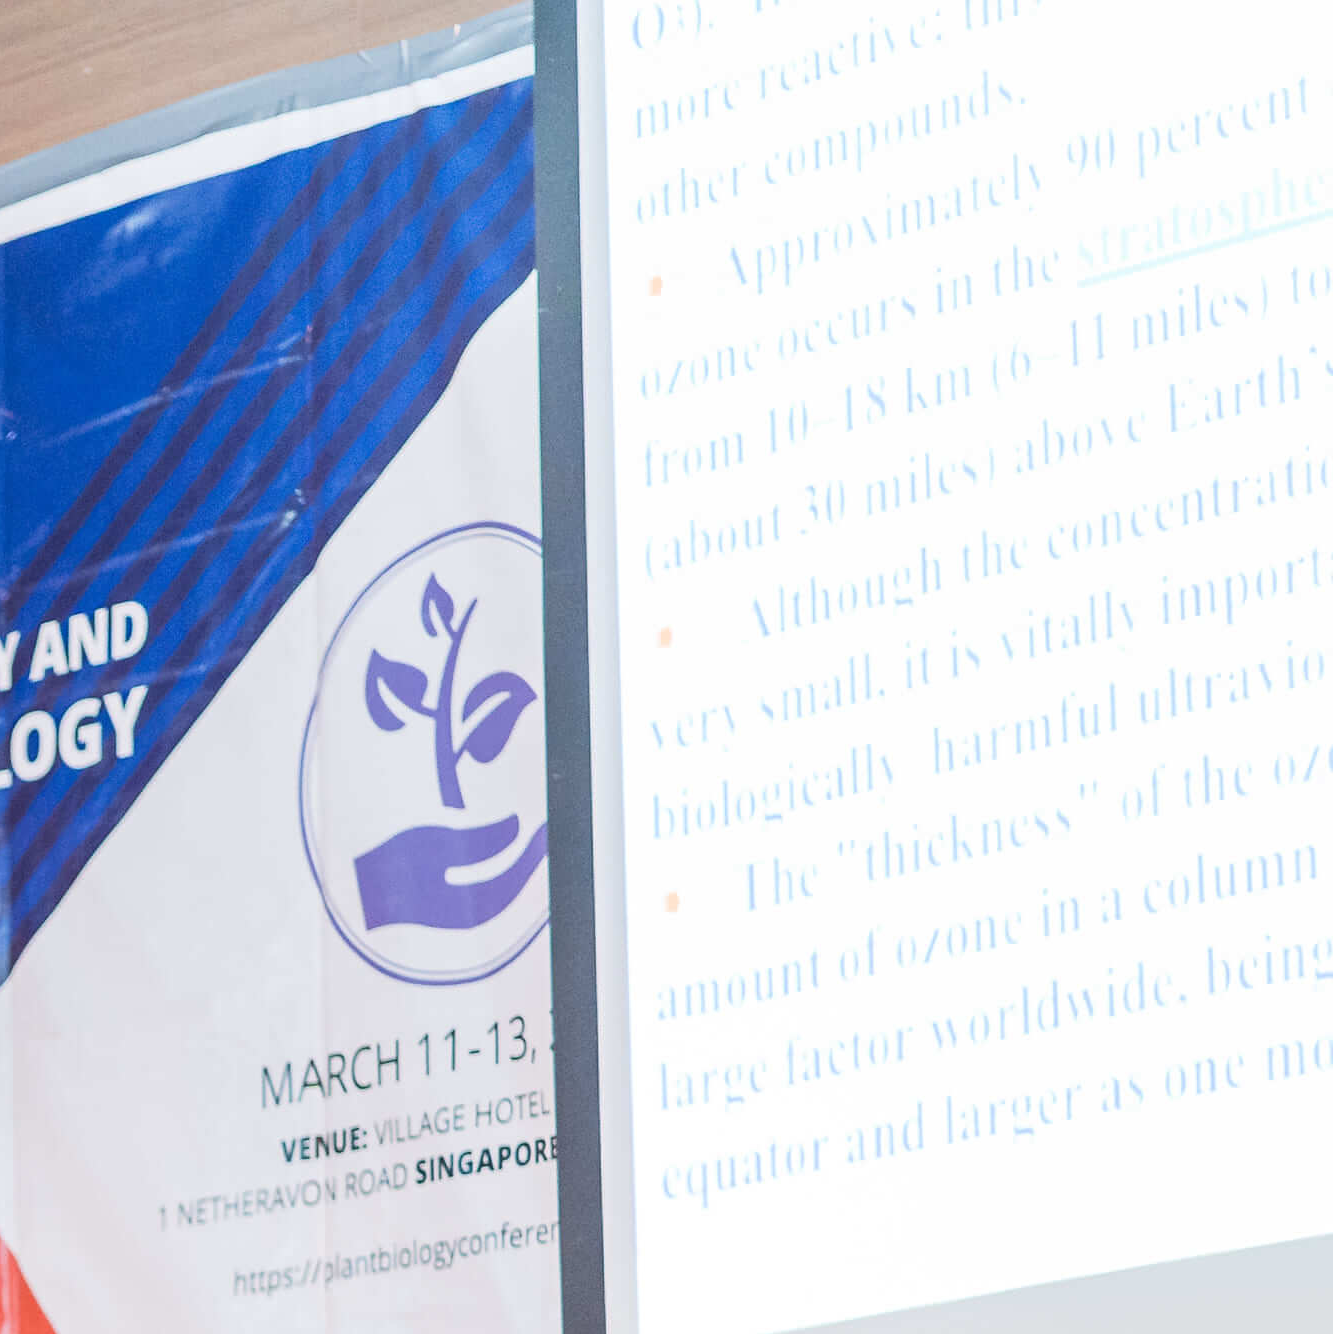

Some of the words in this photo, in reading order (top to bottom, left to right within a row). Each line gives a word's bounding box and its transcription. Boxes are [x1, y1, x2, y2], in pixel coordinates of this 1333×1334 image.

[635, 80, 740, 138] more
[635, 162, 750, 224] other
[763, 68, 1027, 173] compounds.
[723, 150, 1044, 295] Approximately
[1065, 128, 1117, 176] 90
[1135, 75, 1309, 180] percent
[638, 336, 763, 399] ozone
[777, 297, 917, 360] occurs
[933, 266, 975, 314] in
[993, 242, 1060, 296] the
[643, 432, 745, 488] from
[902, 363, 975, 414] km
[1132, 274, 1270, 350] miles)
[1291, 263, 1333, 304] to
[643, 503, 781, 580] (about
[797, 480, 847, 536] 30
[865, 440, 997, 517] miles)
[1013, 413, 1146, 475] above
[29, 600, 150, 683] AND
[647, 703, 737, 752] very
[906, 640, 931, 690] it
[950, 628, 981, 680] is
[999, 588, 1135, 662] vitally
[1161, 546, 1333, 626] import
[743, 545, 942, 638] Although
[961, 527, 1029, 583] the
[651, 743, 895, 840] biologically
[933, 690, 1118, 776] harmful
[736, 857, 818, 911] The
[1123, 763, 1167, 820] of
[1185, 754, 1253, 808] the
[1271, 744, 1333, 788] oz
[655, 946, 820, 1021] amount
[838, 922, 884, 982] of
[895, 911, 1022, 968] ozone
[1042, 887, 1081, 938] in
[1101, 888, 1123, 922] a
[1143, 845, 1318, 912] column
[260, 1038, 401, 1109] MARCH
[660, 1060, 767, 1112] large
[785, 1025, 914, 1087] factor
[1207, 930, 1333, 995] being
[159, 1206, 167, 1231] 1
[177, 1176, 337, 1228] NETHERAVON
[344, 1162, 409, 1198] ROAD
[281, 1126, 368, 1164] VENUE:
[373, 1104, 465, 1147] VILLAGE
[474, 1090, 550, 1130] HOTEL
[660, 1137, 829, 1210] equator
[846, 1098, 925, 1165] and
[946, 1084, 1084, 1145] larger
[1101, 1072, 1145, 1112] as
[1165, 1053, 1245, 1100] one
